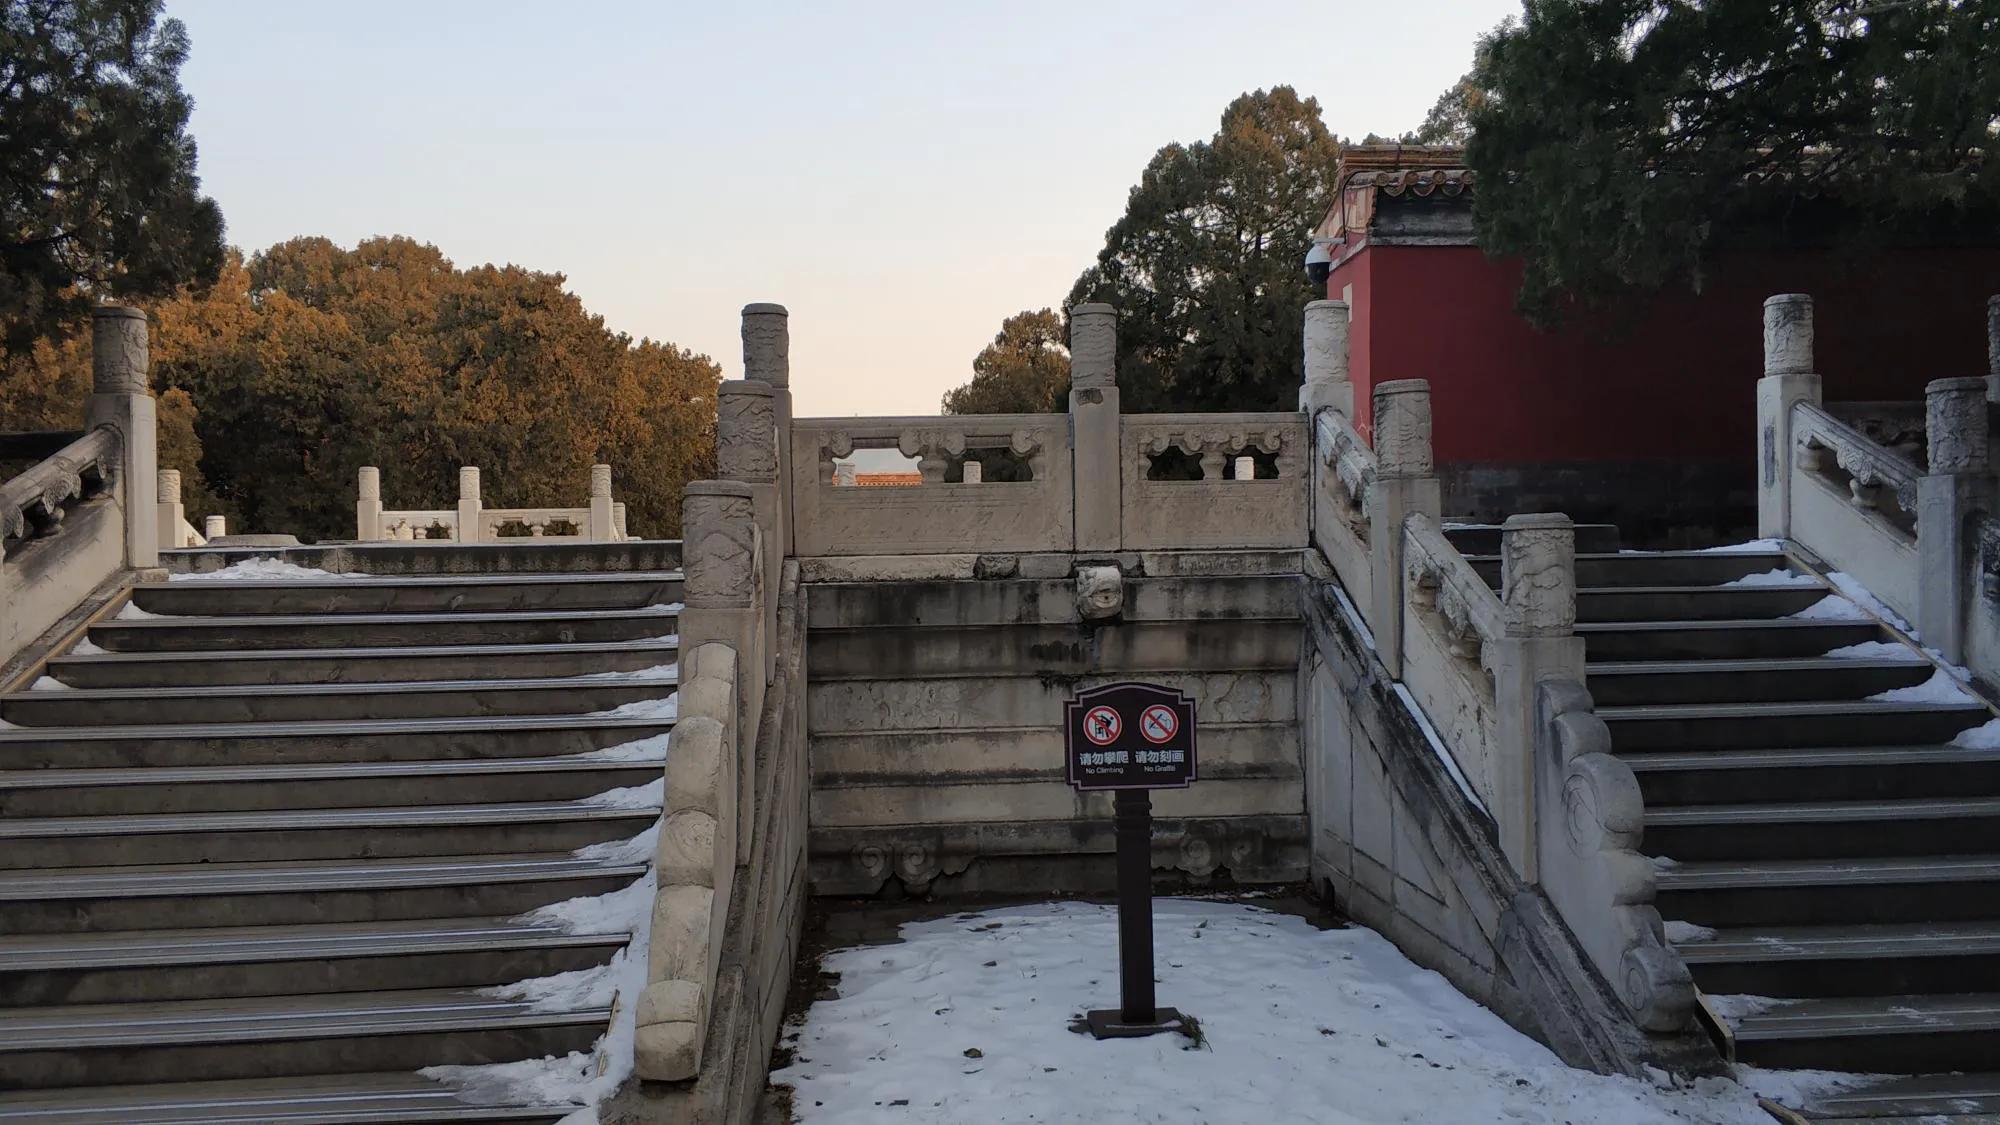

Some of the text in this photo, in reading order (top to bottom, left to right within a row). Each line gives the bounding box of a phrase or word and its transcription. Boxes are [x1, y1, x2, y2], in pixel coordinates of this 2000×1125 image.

[1079, 751, 1129, 765] 请勿攀爬
[1135, 750, 1184, 763] 请勿刻画
[1096, 766, 1124, 774] Climbing
